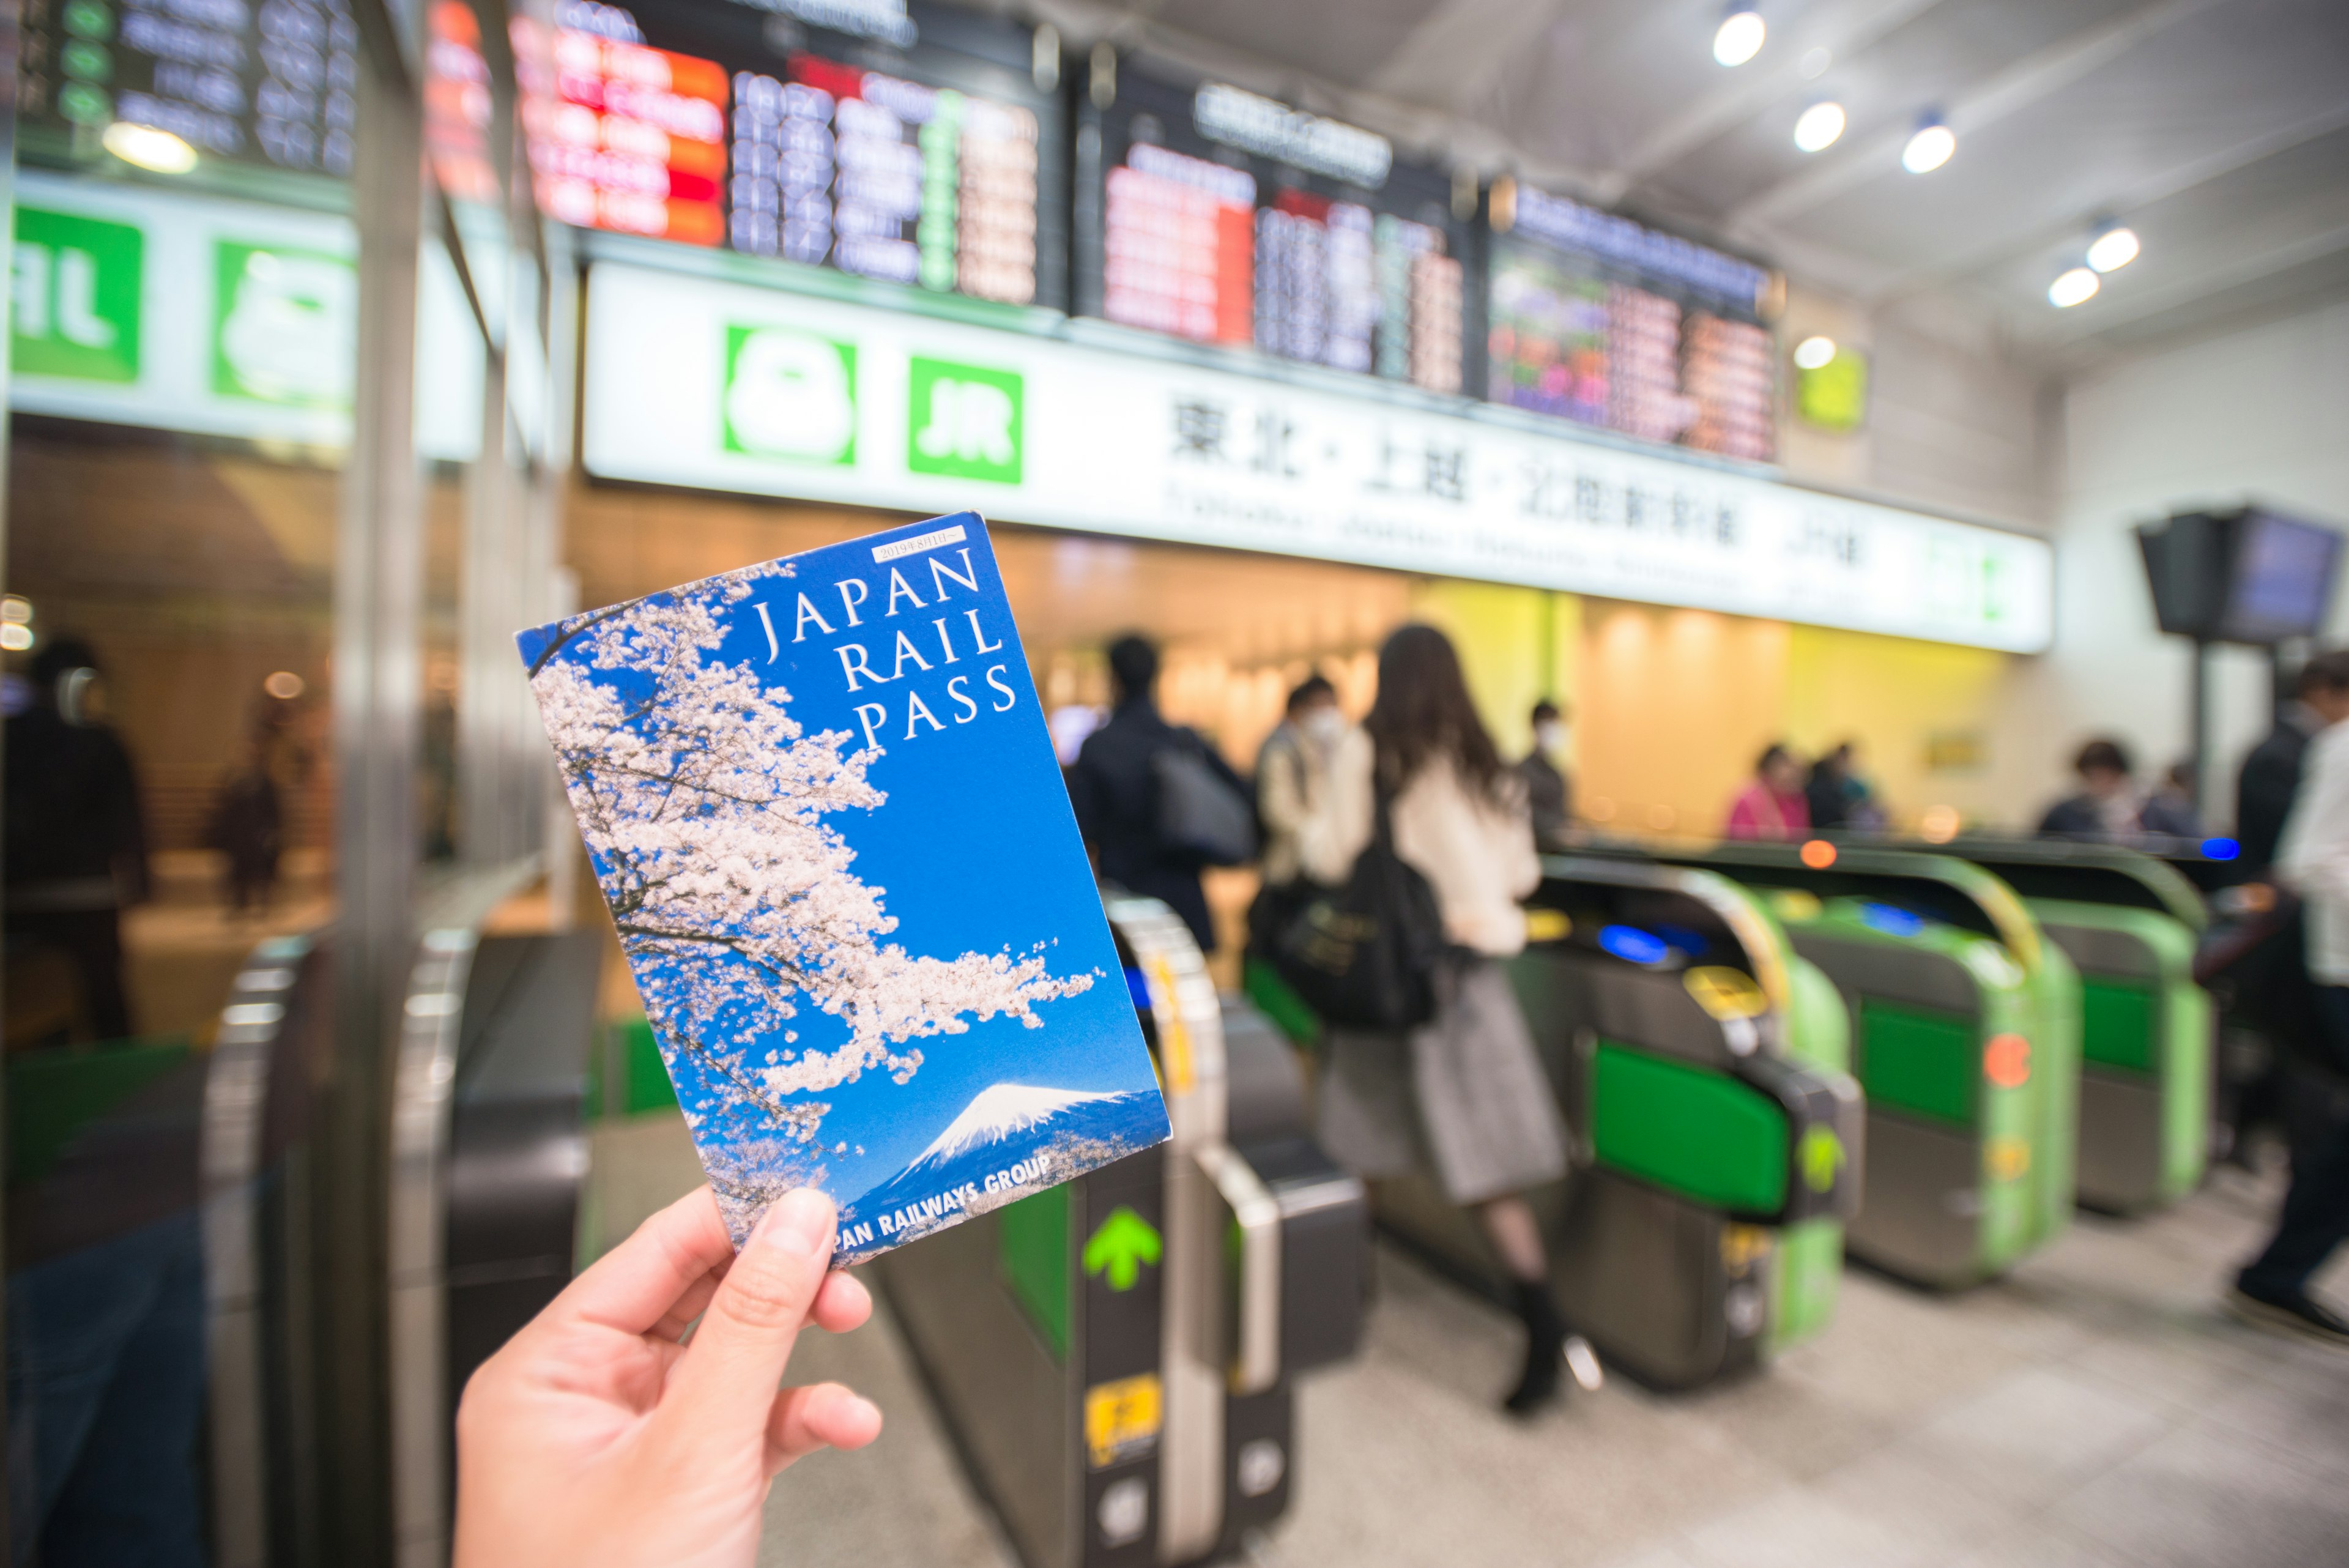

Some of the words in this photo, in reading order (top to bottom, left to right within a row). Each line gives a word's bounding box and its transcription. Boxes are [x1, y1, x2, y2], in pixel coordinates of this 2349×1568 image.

[916, 377, 1016, 466] JR
[752, 548, 979, 666] JAPAN
[833, 609, 1003, 693] RAIL
[853, 664, 1016, 751] PASS
[833, 1221, 874, 1254] PAN
[878, 1181, 979, 1236] RAILWAYS
[984, 1155, 1051, 1195] GROUP
